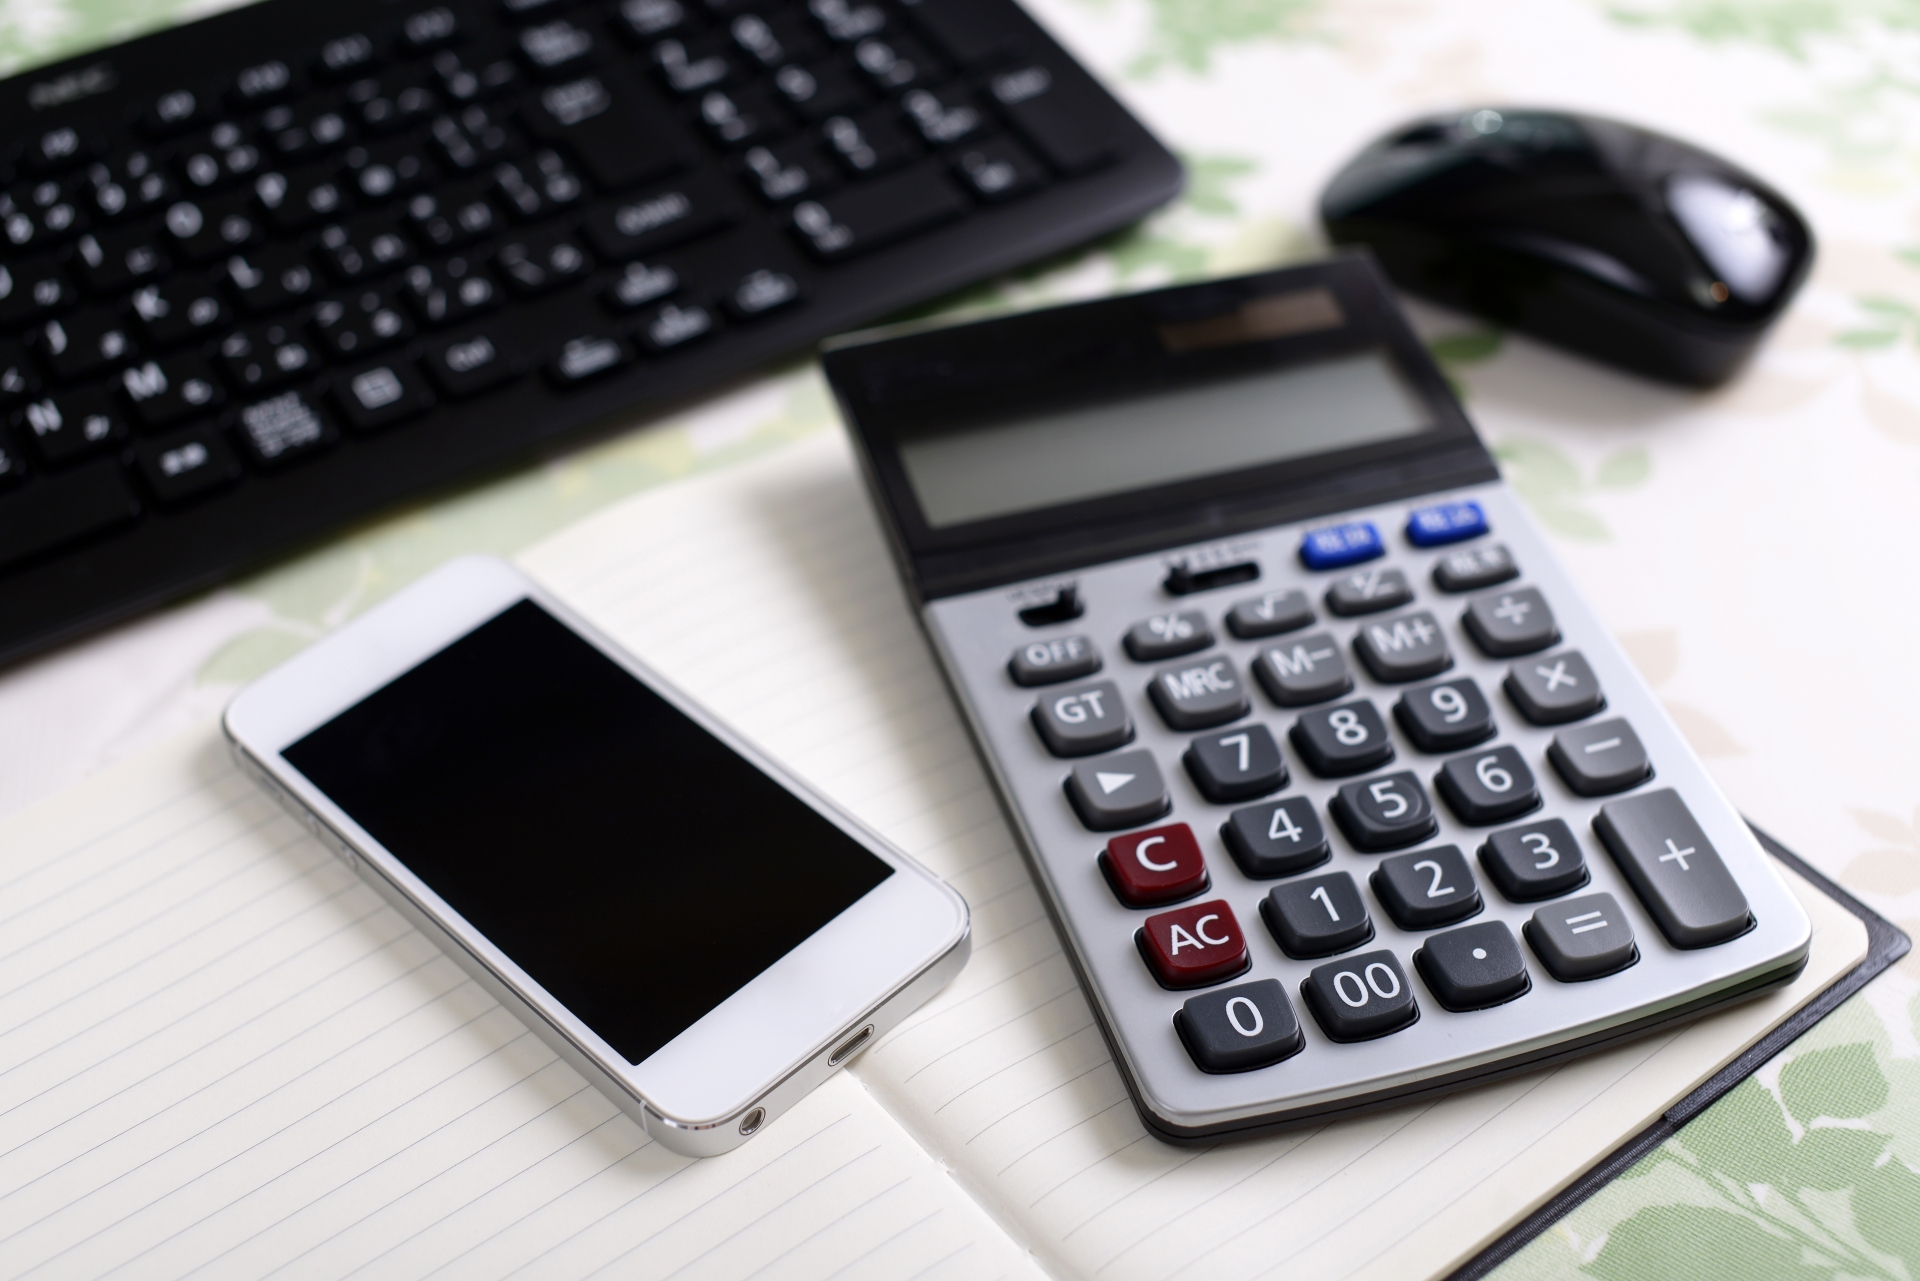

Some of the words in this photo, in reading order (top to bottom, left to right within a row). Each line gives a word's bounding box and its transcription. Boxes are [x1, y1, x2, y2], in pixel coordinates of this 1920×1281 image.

[122, 361, 168, 401] M
[26, 399, 62, 436] N
[1148, 612, 1194, 643] %
[1370, 616, 1436, 653] M+
[1026, 637, 1082, 667] OFF
[1164, 662, 1235, 702] MRC
[1054, 690, 1104, 724] GT
[1430, 685, 1469, 723] 9
[1328, 708, 1368, 746] 8
[1218, 733, 1250, 772] 7
[1475, 754, 1514, 793] 6
[1368, 779, 1409, 818] 5
[1267, 807, 1304, 843] 4
[1135, 835, 1179, 873] C
[1520, 832, 1560, 870] 3
[1412, 859, 1456, 899] 2
[1309, 886, 1341, 923] 1
[1170, 913, 1230, 957] AC
[1332, 961, 1401, 1008] 00
[1225, 995, 1265, 1038] 0
